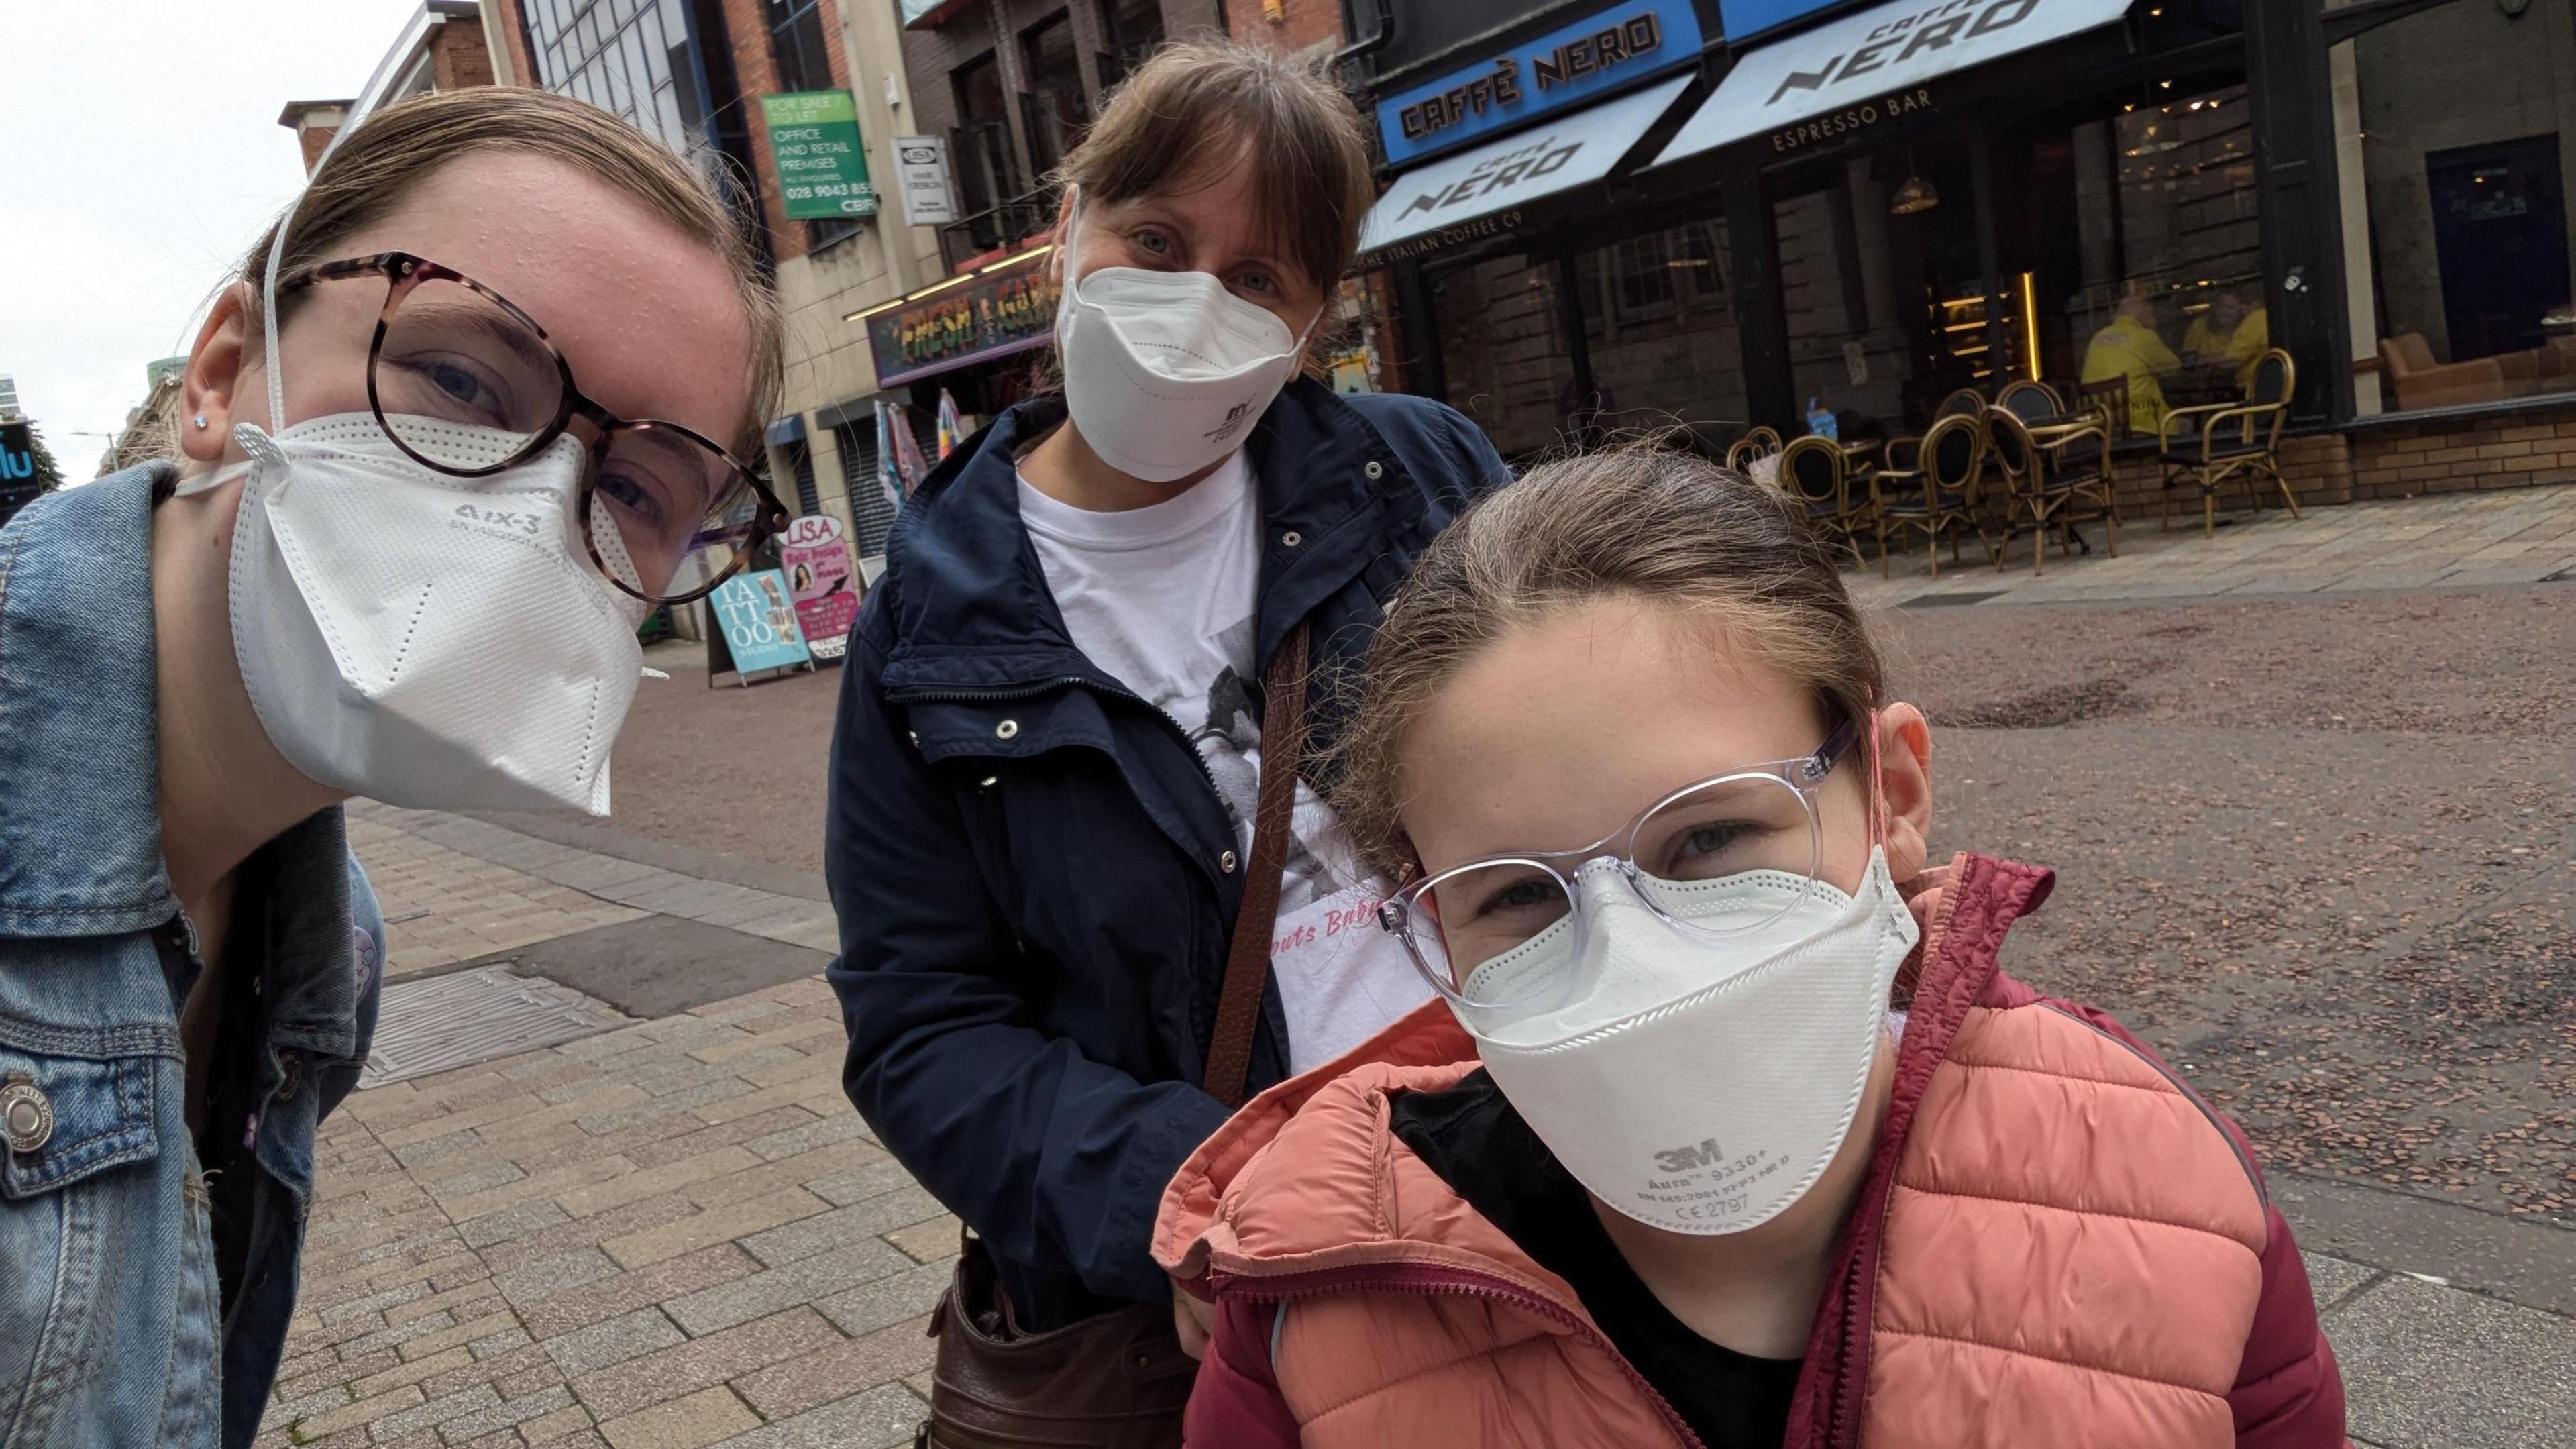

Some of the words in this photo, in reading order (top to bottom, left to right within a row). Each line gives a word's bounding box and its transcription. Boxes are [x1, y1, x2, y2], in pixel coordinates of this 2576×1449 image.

[1533, 11, 1662, 92] NERO
[1765, 0, 2040, 107] NERO
[768, 98, 796, 111] FOR
[801, 97, 832, 109] SALE
[770, 112, 793, 124] TO
[796, 110, 818, 122] LET
[1772, 105, 1878, 152] ESPRESSO
[1888, 89, 1932, 117] BAR
[773, 129, 822, 142] OFFICE
[778, 144, 808, 156] AND
[810, 142, 851, 154] RETAIL
[780, 157, 838, 170] PREMISES
[786, 186, 813, 199] 028
[814, 184, 849, 197] 9043
[1395, 142, 1585, 223] NERO
[1388, 237, 1440, 261] ITALIAN
[1443, 219, 1497, 246] COFFEE
[786, 519, 834, 545] LISA
[719, 578, 757, 604] TA
[722, 598, 760, 625] TT
[731, 621, 772, 647] OO
[1654, 1138, 1724, 1173] 3M
[1723, 1175, 1757, 1195] FFP3
[1758, 1163, 1779, 1177] NR
[1780, 1155, 1790, 1165] D
[1705, 1193, 1750, 1218] 2797
